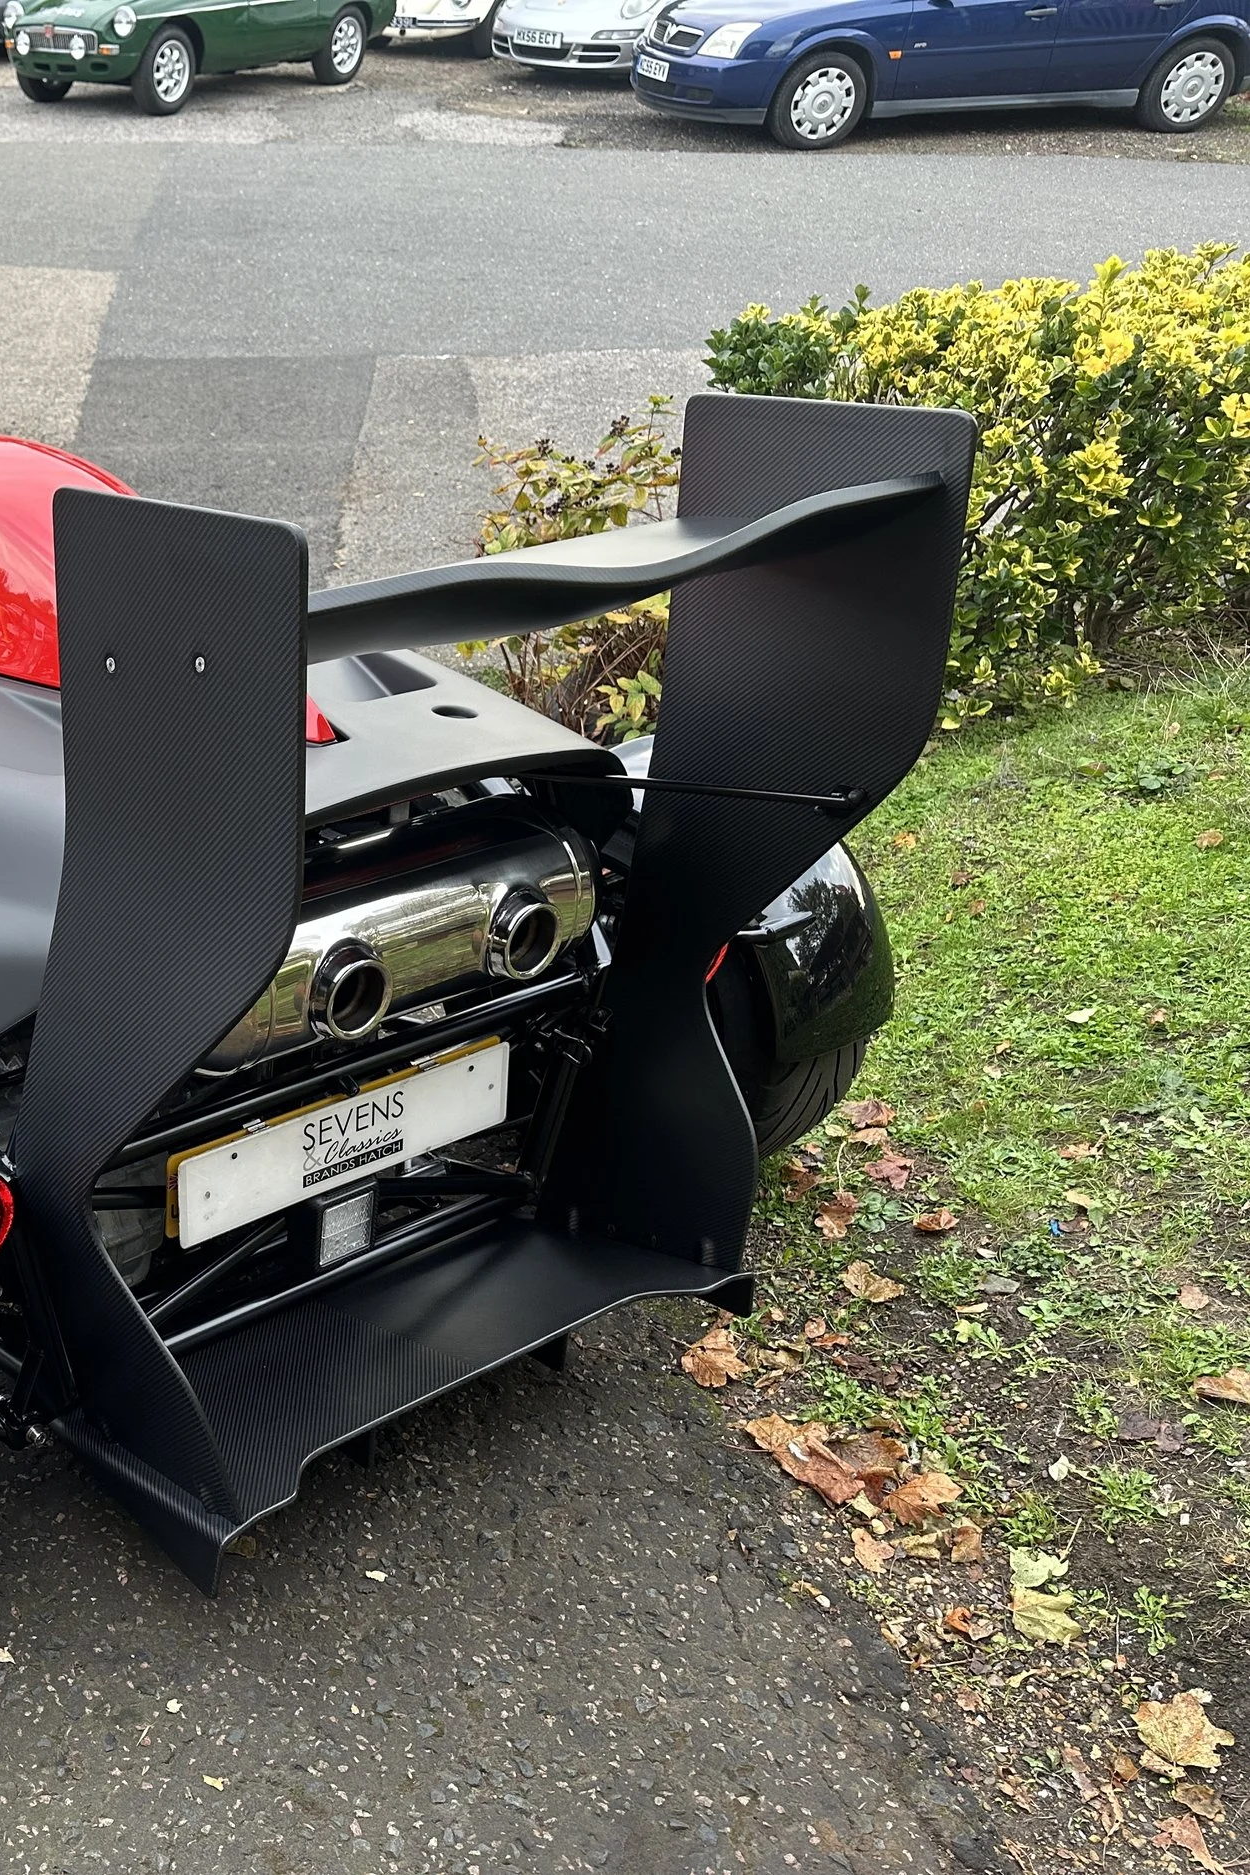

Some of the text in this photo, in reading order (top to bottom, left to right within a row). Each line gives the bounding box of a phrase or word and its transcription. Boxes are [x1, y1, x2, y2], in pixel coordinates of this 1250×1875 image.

[538, 32, 557, 45] ECT
[302, 1090, 404, 1151] SEVENS
[302, 1128, 403, 1172] & Classics
[305, 1141, 401, 1186] BRANDS HATCH
